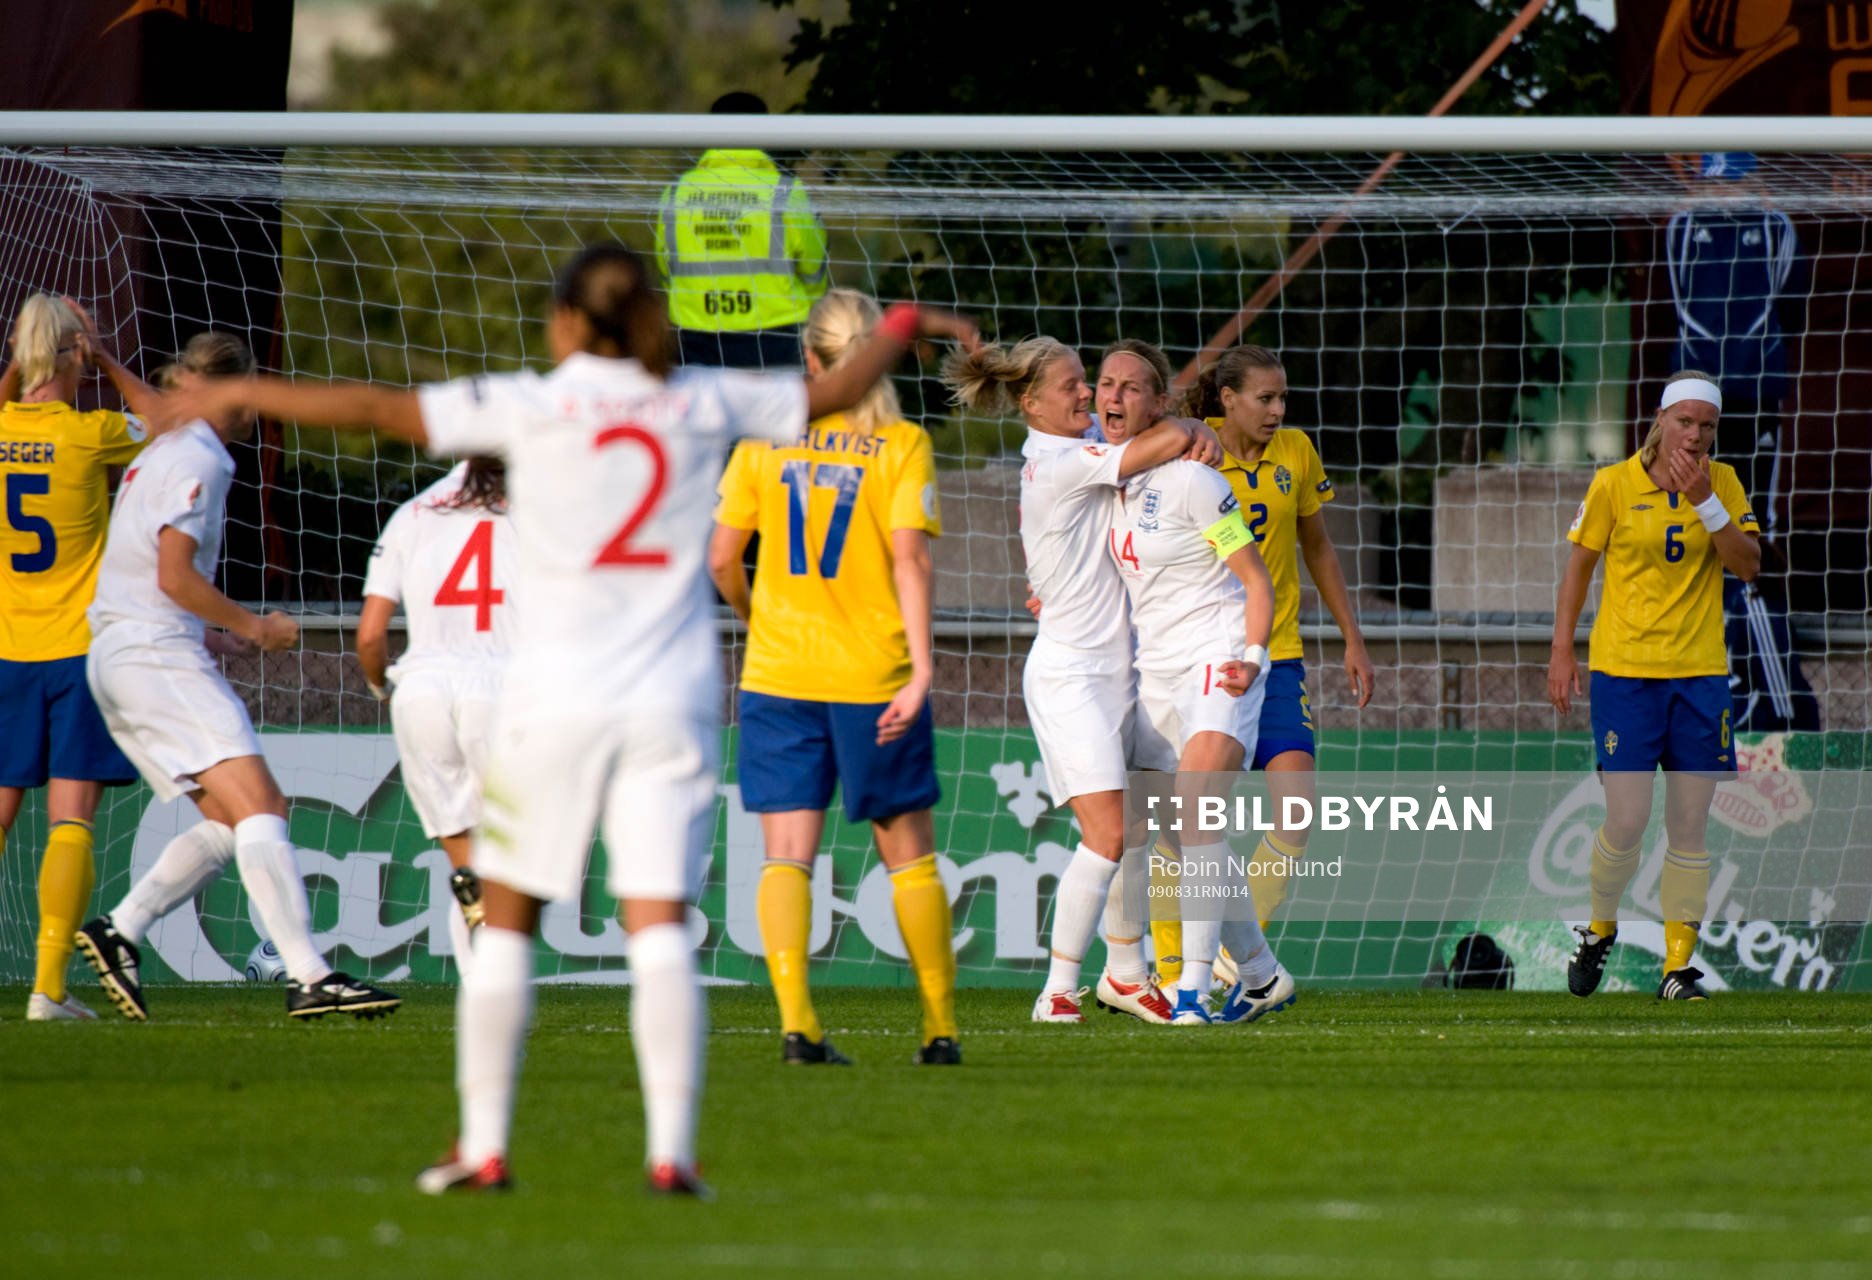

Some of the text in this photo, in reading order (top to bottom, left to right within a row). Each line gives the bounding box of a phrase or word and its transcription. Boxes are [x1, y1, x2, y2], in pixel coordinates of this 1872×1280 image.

[704, 290, 752, 315] 659
[0, 442, 56, 463] SEGER
[771, 429, 887, 458] HLKVIST
[592, 424, 671, 570] 2
[6, 473, 58, 573] 5
[780, 460, 865, 579] 17
[1248, 503, 1268, 542] 2
[1109, 527, 1141, 571] 14
[1665, 525, 1685, 563] 6
[433, 520, 506, 633] 4
[1720, 708, 1731, 748] 6
